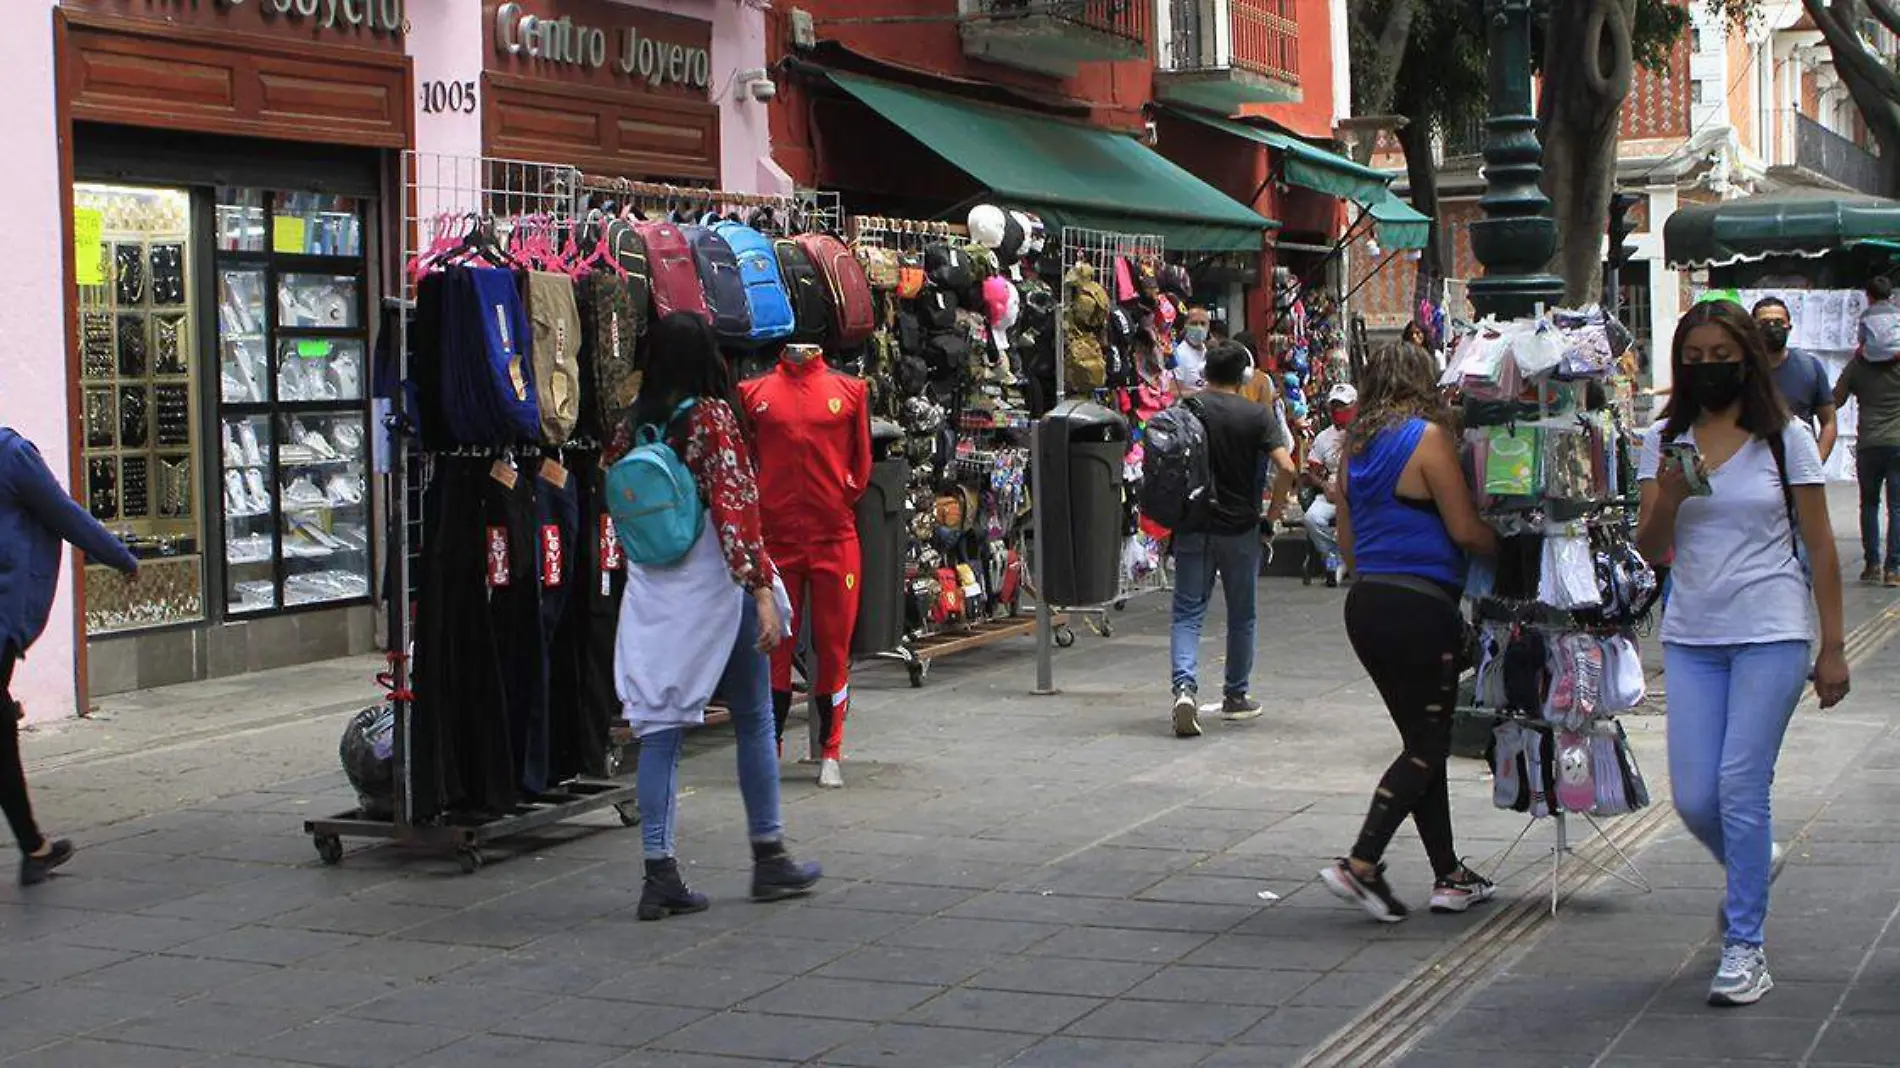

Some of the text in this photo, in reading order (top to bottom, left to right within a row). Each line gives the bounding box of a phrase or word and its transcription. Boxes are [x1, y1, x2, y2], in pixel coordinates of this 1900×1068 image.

[497, 2, 708, 87] Centro Joyero
[422, 80, 476, 114] 1005
